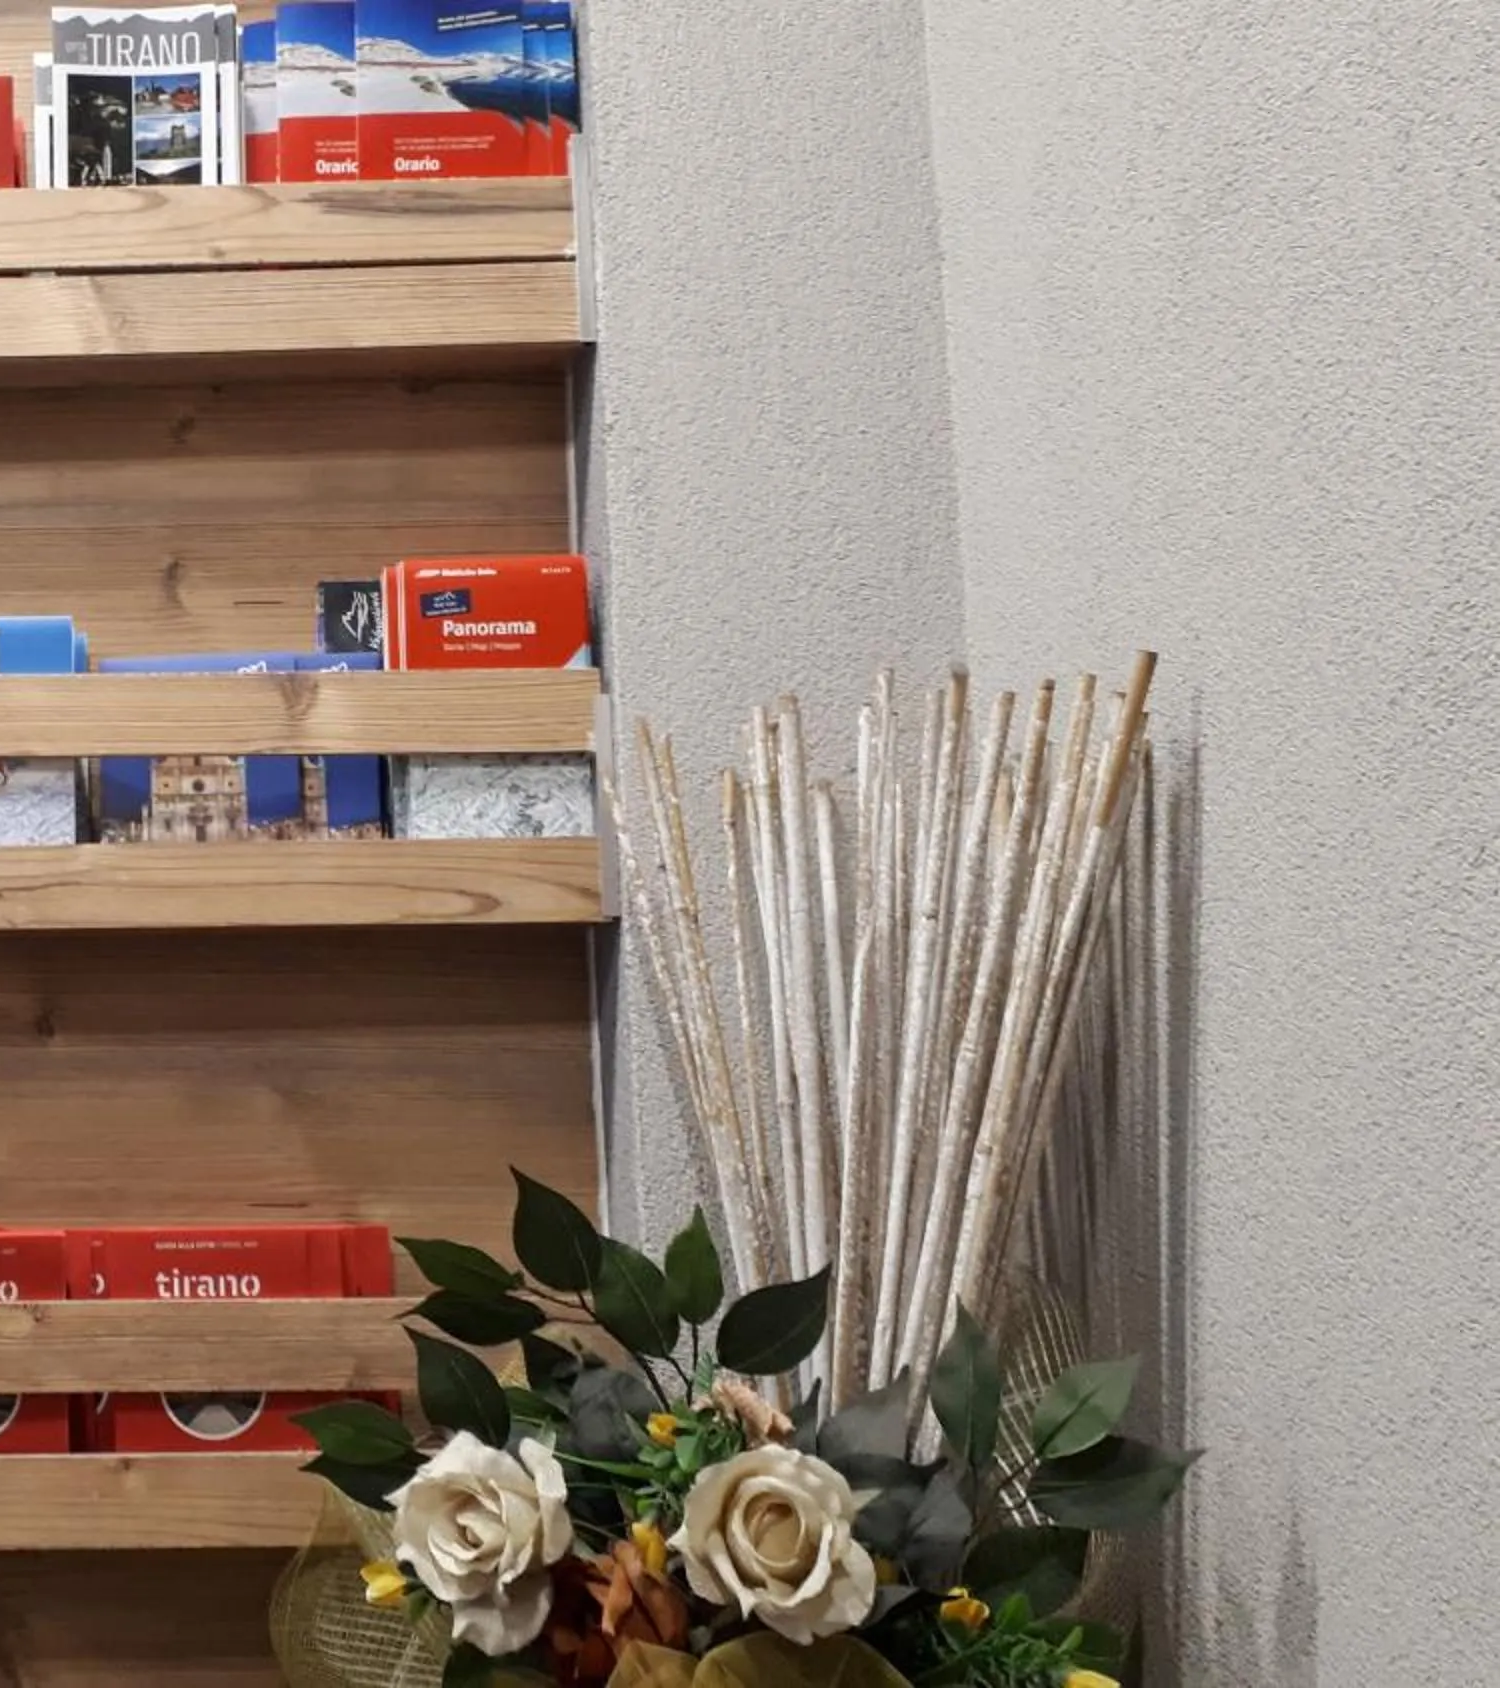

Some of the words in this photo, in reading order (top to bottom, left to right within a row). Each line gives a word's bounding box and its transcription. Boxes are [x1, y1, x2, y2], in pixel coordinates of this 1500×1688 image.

[85, 32, 200, 67] TIRANO
[394, 155, 441, 172] Orario
[443, 620, 537, 637] Panorama
[155, 1267, 261, 1298] tirano
